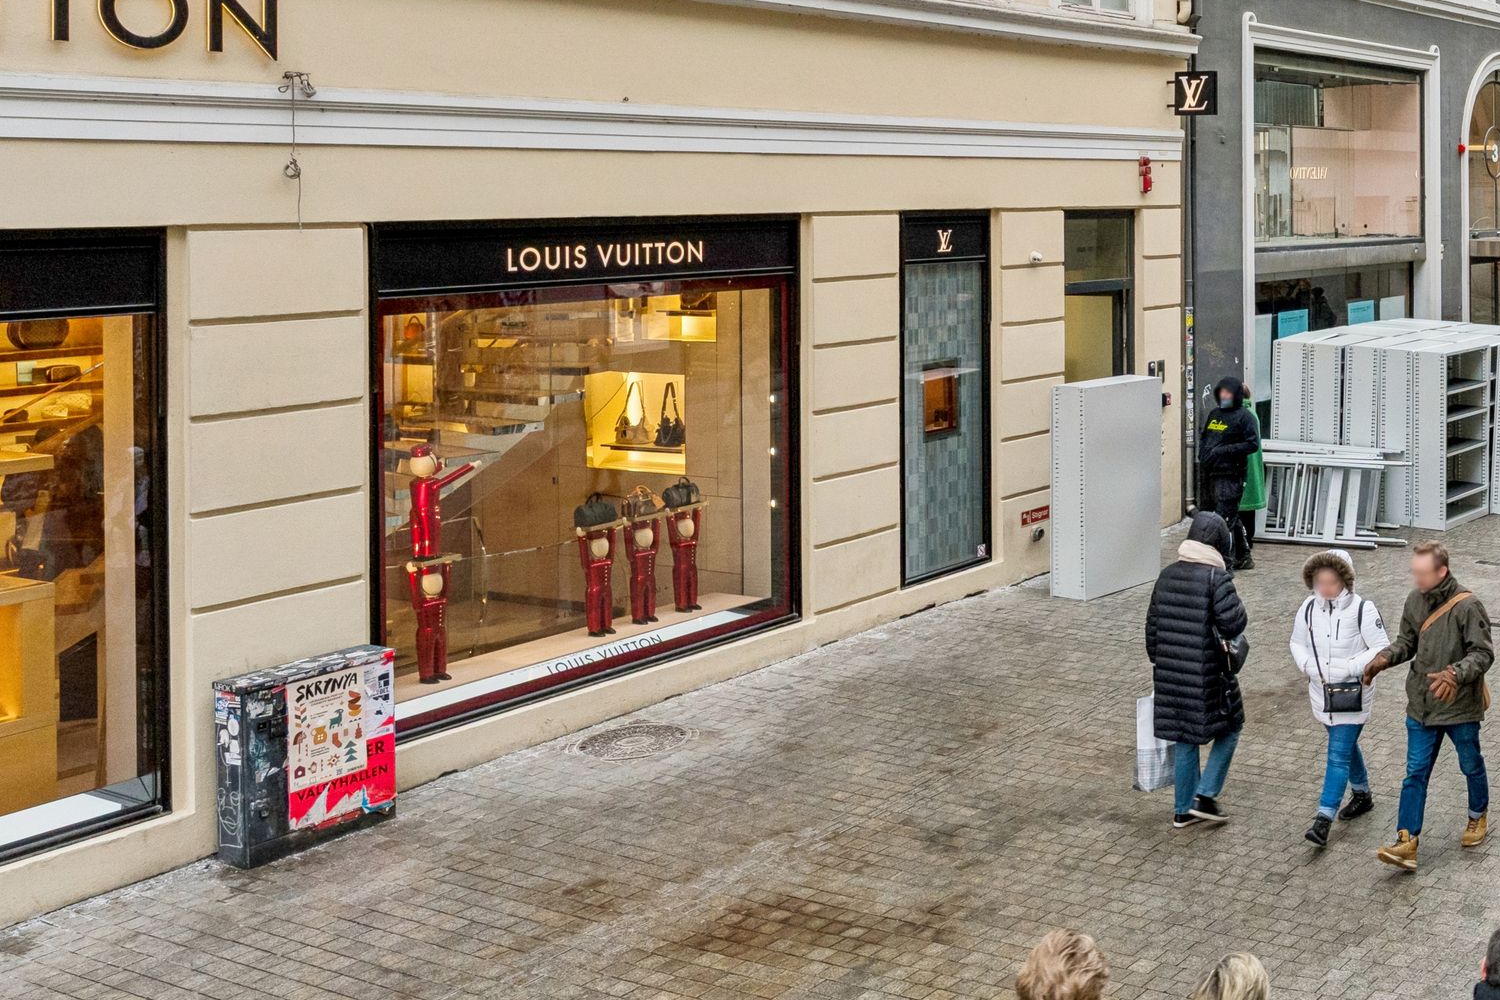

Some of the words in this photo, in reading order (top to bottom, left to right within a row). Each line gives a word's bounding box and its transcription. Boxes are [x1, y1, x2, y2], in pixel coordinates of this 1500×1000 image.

[1491, 143, 1499, 163] 3
[507, 244, 588, 272] LOUIS
[596, 240, 704, 268] VUITTON
[597, 634, 664, 660] VUITTON
[295, 672, 358, 704] SKRYNYA
